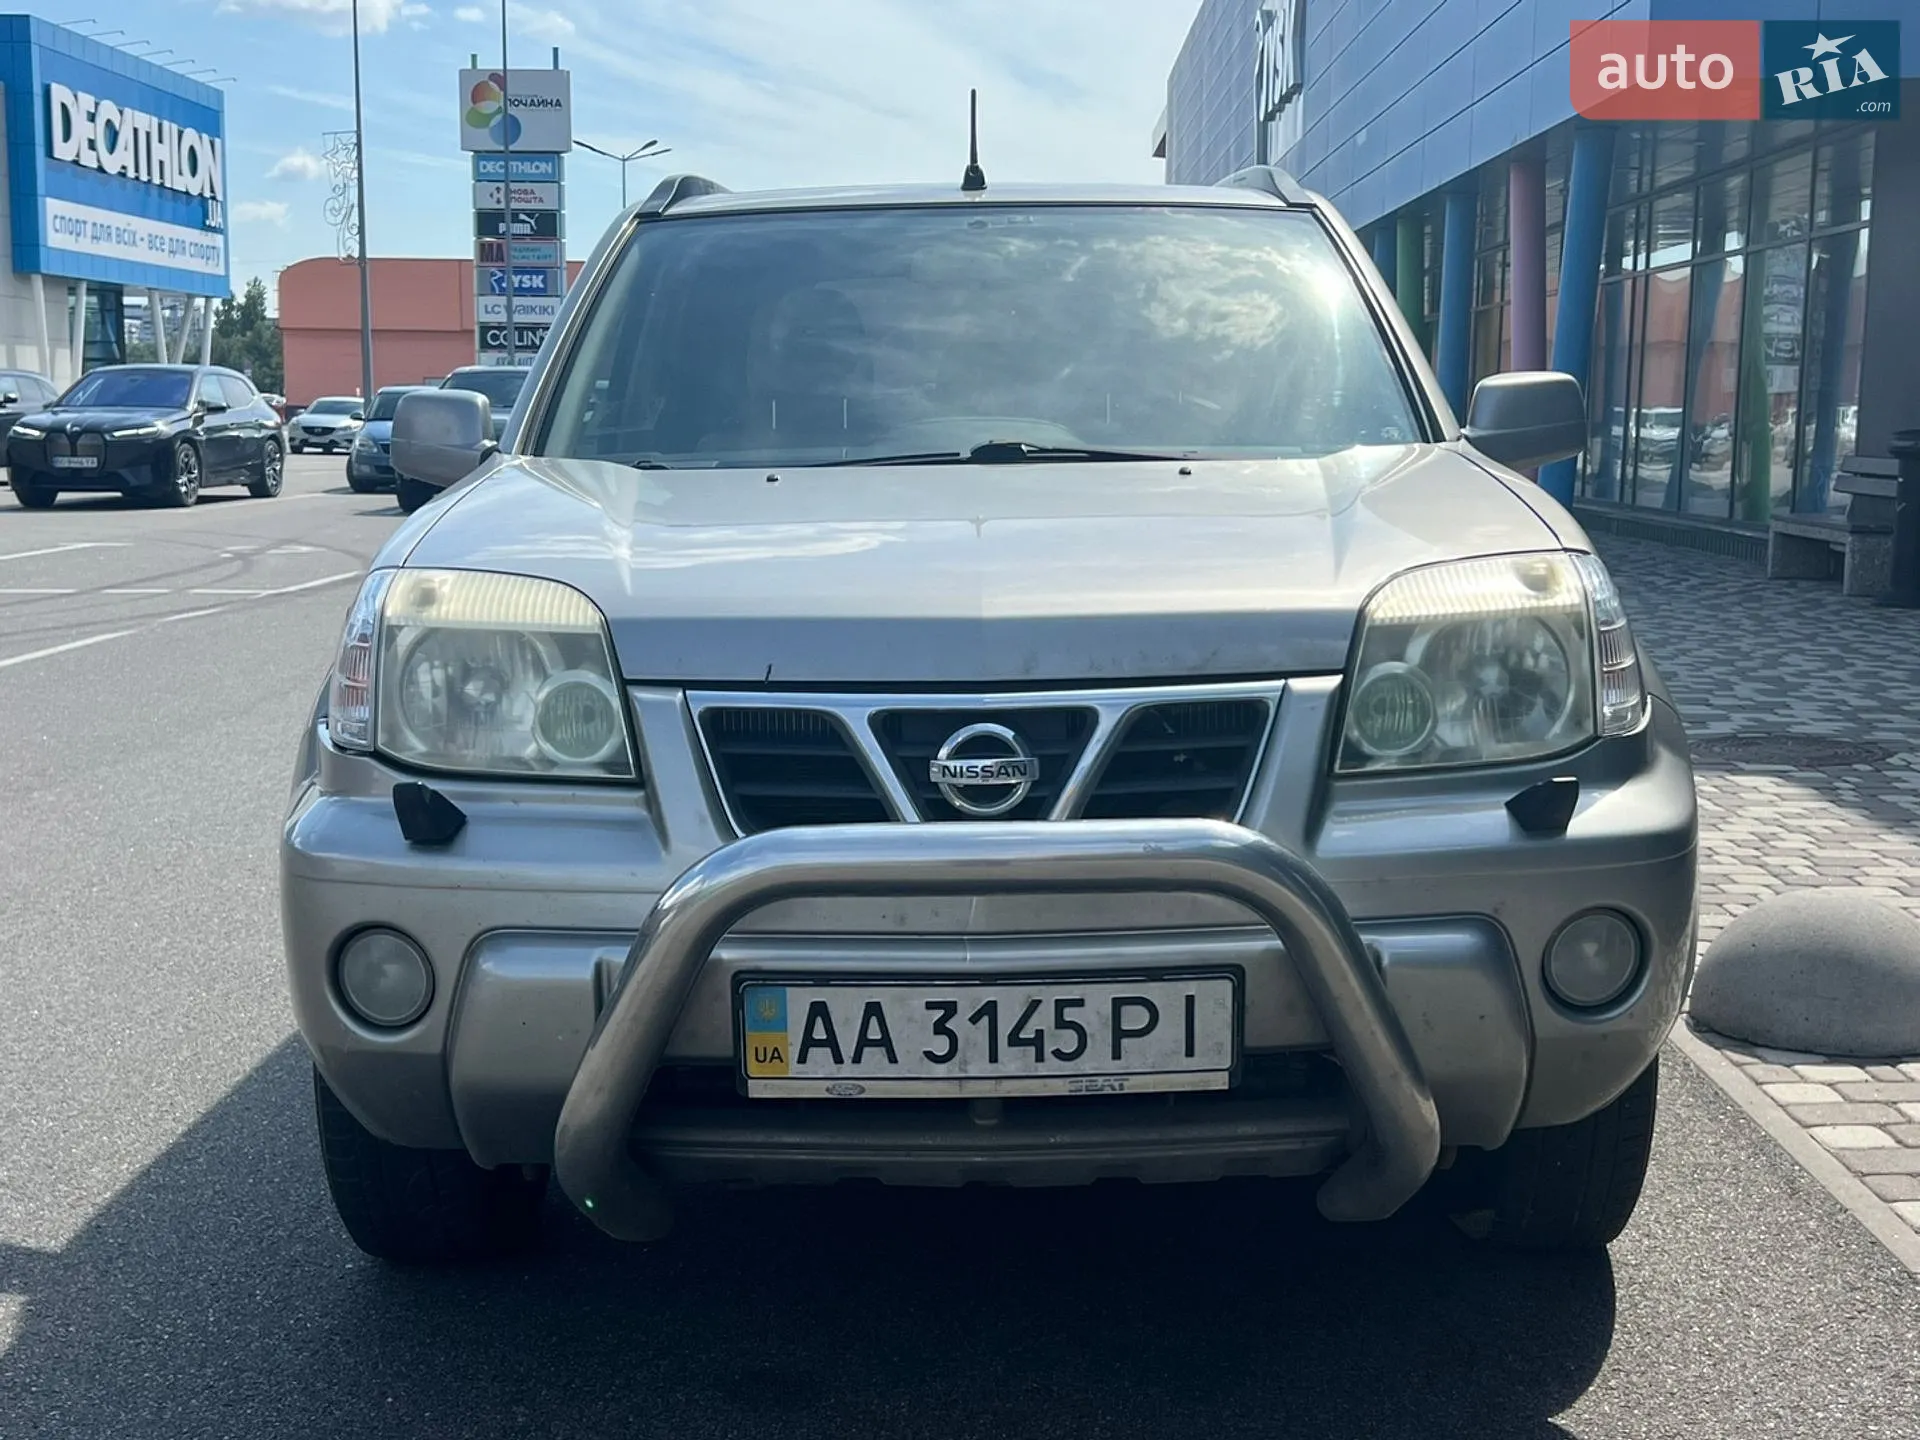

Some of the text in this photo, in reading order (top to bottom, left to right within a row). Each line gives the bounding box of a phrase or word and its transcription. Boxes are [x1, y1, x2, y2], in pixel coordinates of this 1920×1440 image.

[50, 82, 223, 200] DECATHLON
[53, 214, 87, 244] спорт
[91, 221, 113, 244] для
[147, 233, 166, 253] все
[168, 237, 187, 258] для
[189, 241, 220, 267] спорту
[484, 304, 502, 315] LC
[942, 763, 1027, 779] NISSAN
[797, 994, 1196, 1065] AA 3145 PI
[754, 1046, 784, 1064] UA
[1068, 1078, 1130, 1093] SEAT
